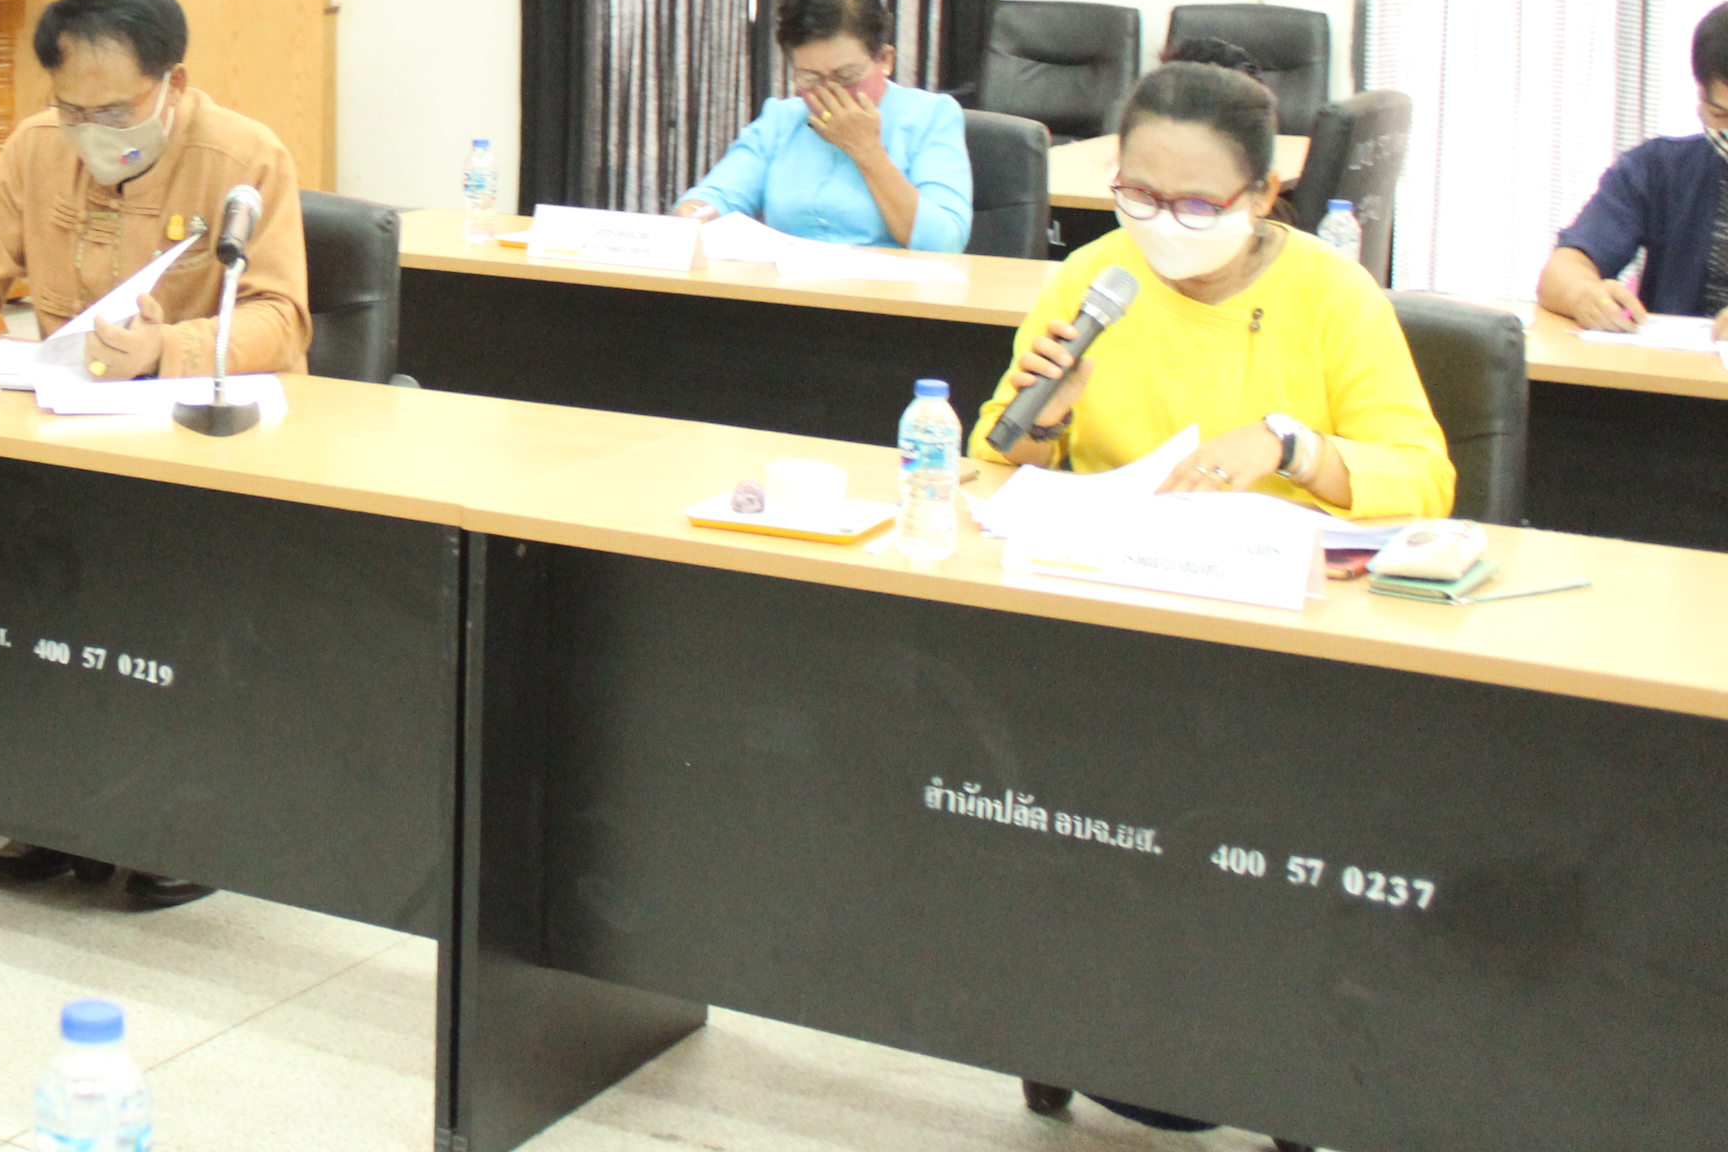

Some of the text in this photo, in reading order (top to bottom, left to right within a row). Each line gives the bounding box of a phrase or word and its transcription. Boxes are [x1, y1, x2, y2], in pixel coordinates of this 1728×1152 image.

[33, 638, 71, 665] 400
[81, 645, 108, 670] 57
[117, 652, 174, 687] 0219
[1210, 844, 1268, 878] 400
[1285, 854, 1326, 887] 57
[1341, 865, 1436, 910] 0237
